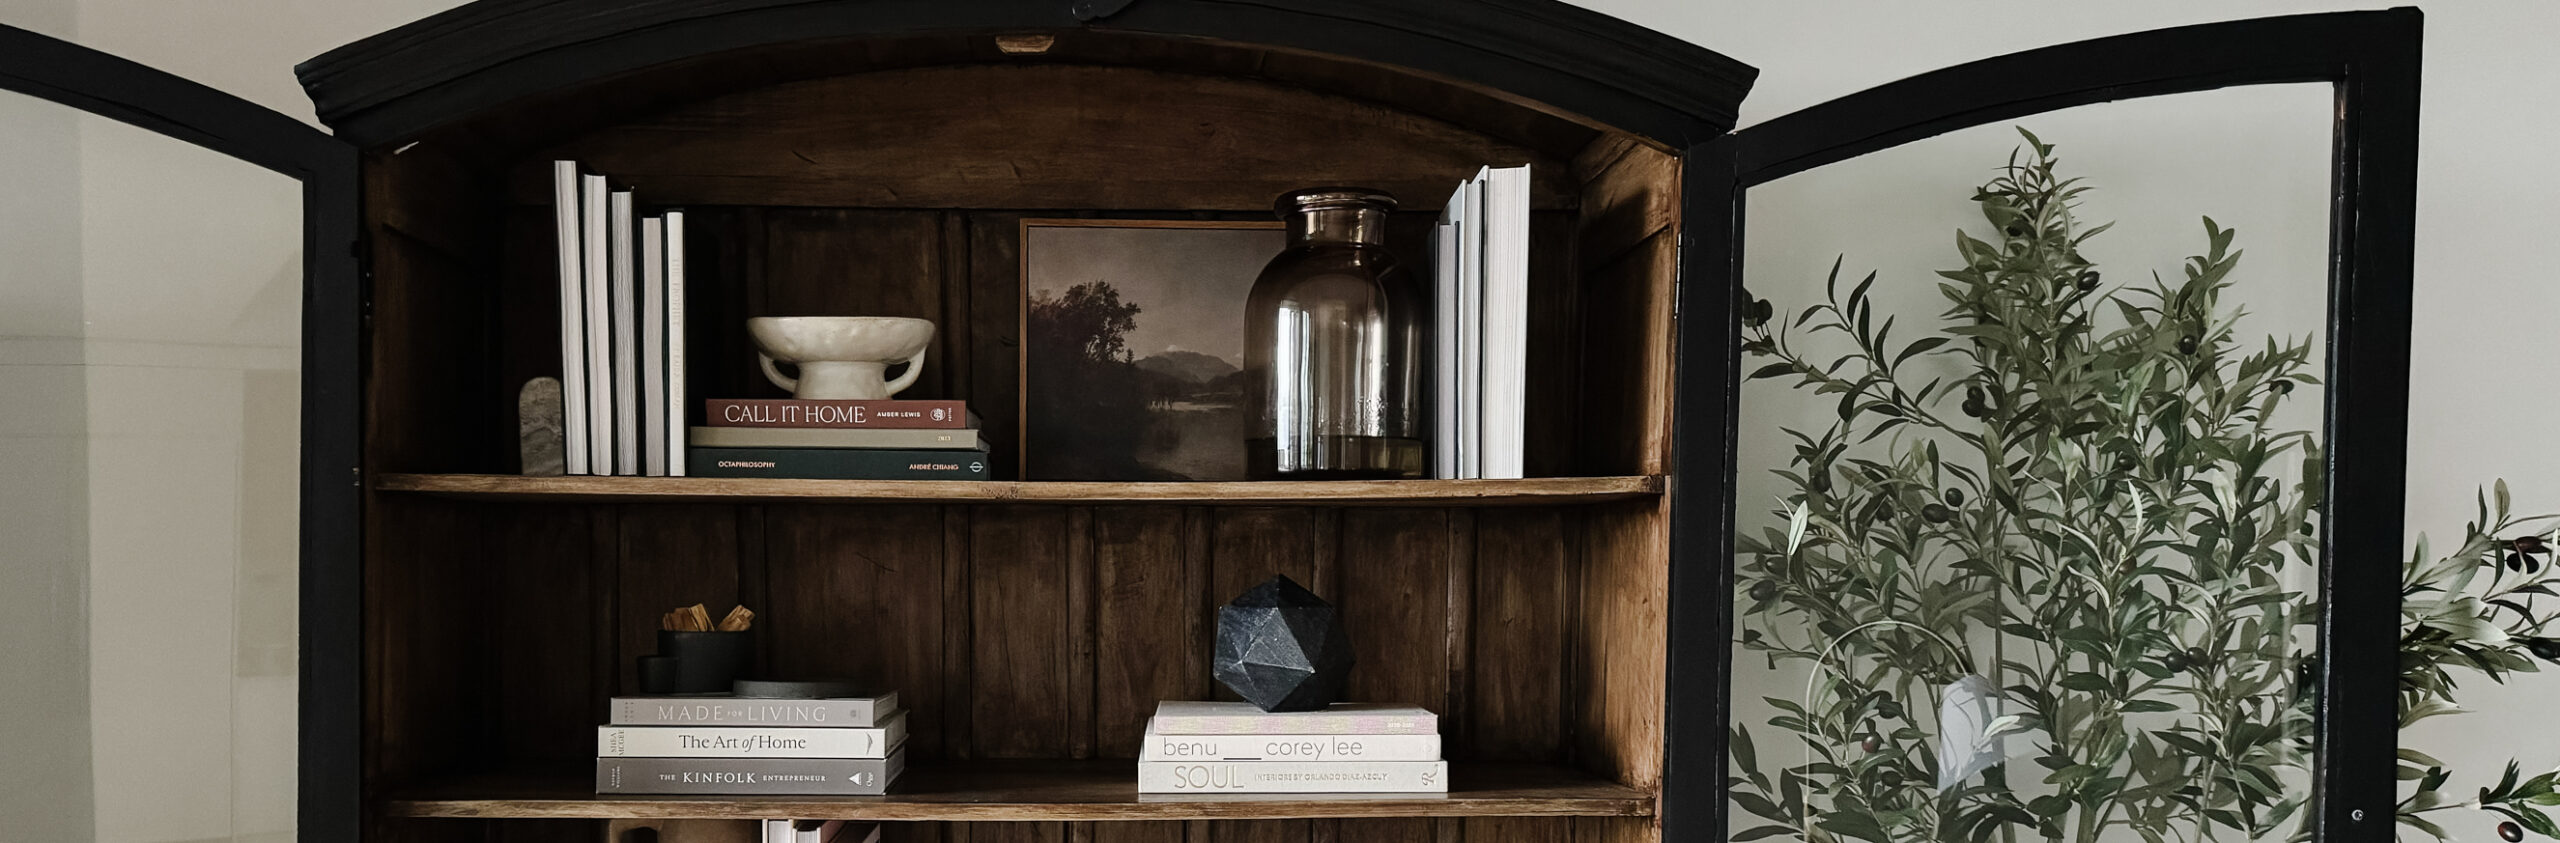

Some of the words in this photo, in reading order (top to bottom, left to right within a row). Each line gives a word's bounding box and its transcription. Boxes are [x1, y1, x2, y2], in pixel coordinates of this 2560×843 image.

[724, 405, 777, 423] CALL
[781, 405, 800, 423] IT
[804, 405, 867, 424] HOME
[718, 460, 776, 468] OCTAPHILOSOPHY
[658, 705, 724, 721] MADE
[748, 706, 827, 722] LIVING
[679, 734, 710, 749] The
[713, 735, 738, 749] Art
[742, 734, 756, 752] of
[758, 735, 806, 749] Home
[1163, 737, 1217, 756] benu
[1266, 741, 1326, 760] corey
[1332, 736, 1363, 756] lee
[683, 772, 757, 783] KINFOLK
[1174, 765, 1244, 788] SOUL
[1304, 773, 1341, 782] ORLANDO
